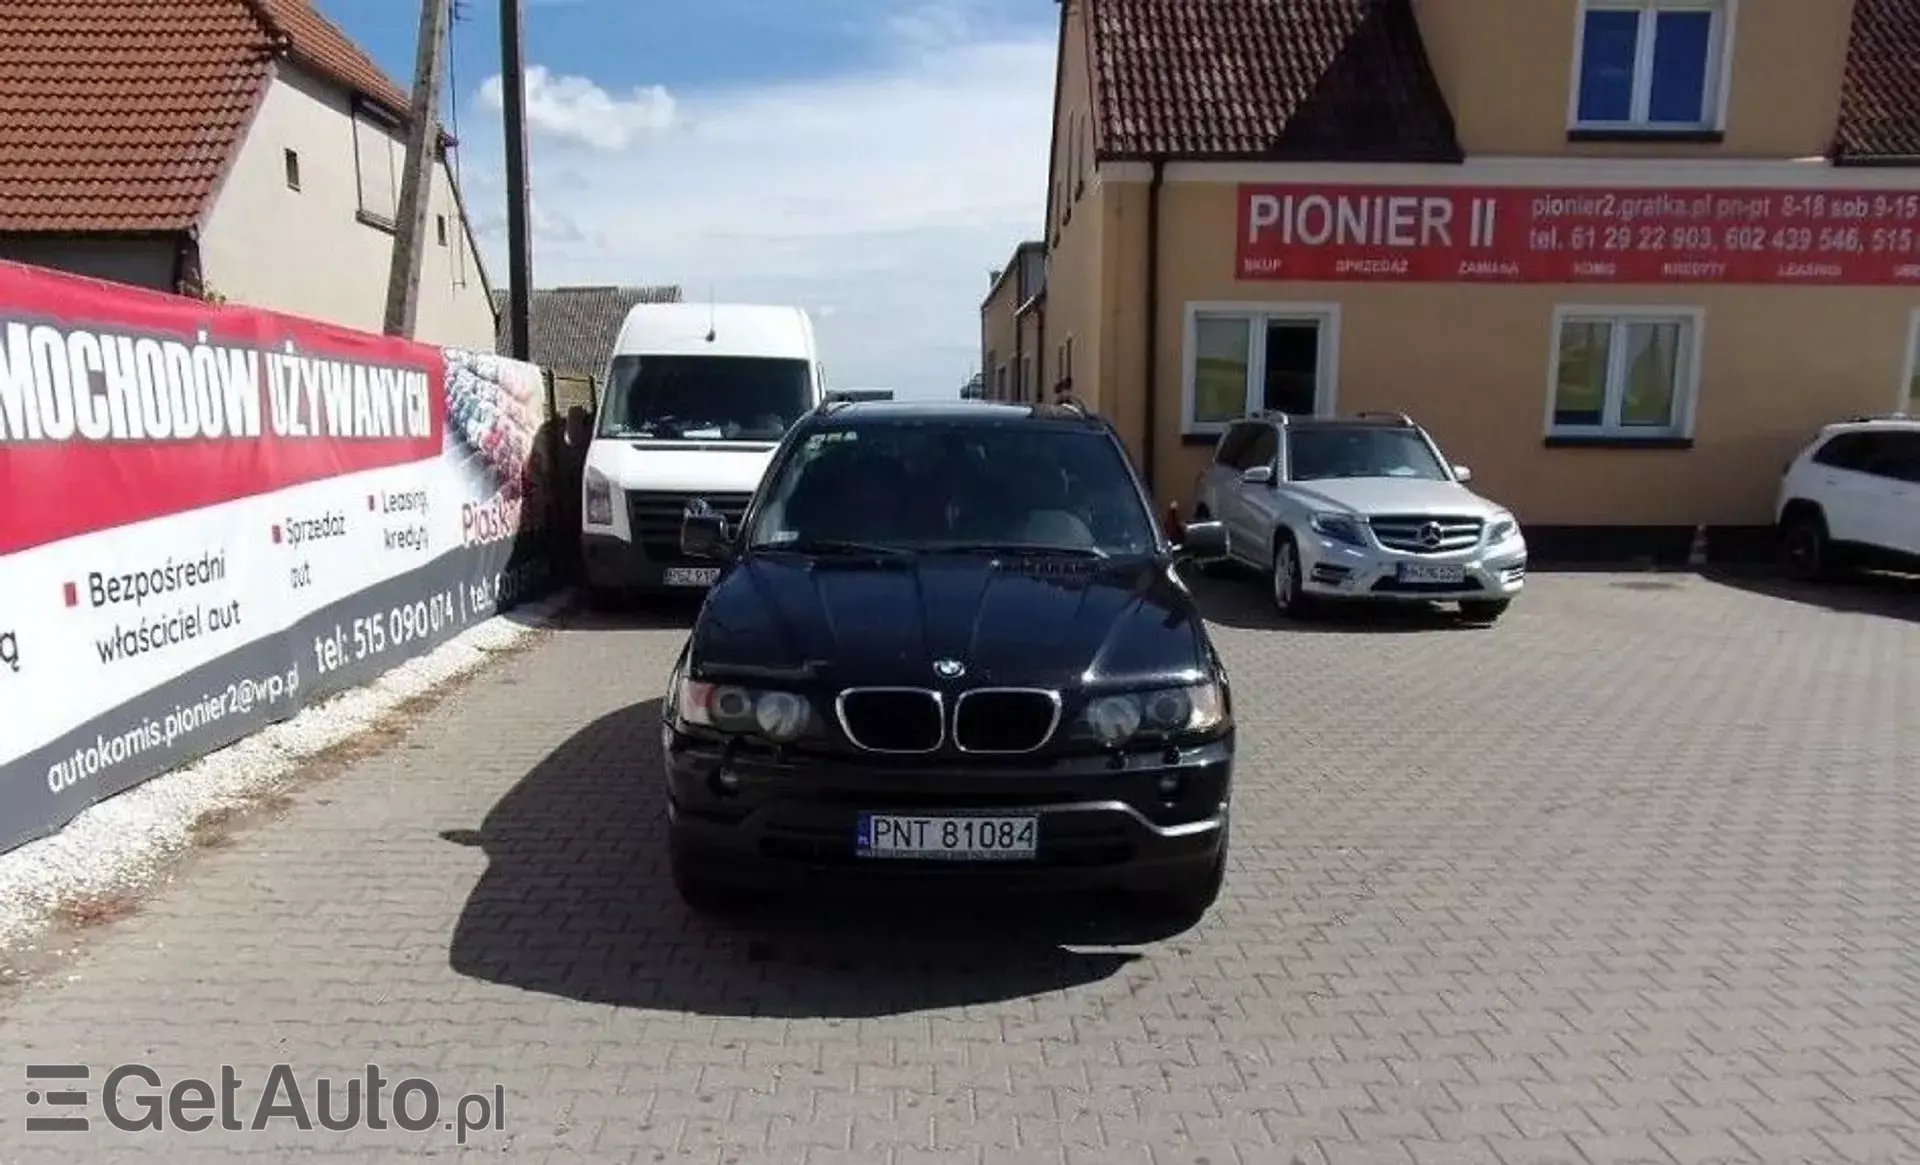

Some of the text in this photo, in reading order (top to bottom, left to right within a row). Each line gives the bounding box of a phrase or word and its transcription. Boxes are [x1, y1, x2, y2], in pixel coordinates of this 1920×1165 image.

[1249, 194, 1496, 247] PIONIER II
[1780, 195, 1825, 218] 8-18
[1831, 196, 1868, 218] sob
[1873, 195, 1918, 219] 9-15
[1529, 226, 1564, 250] tel.
[1571, 227, 1595, 250] 61
[1603, 227, 1631, 250] 29
[1637, 226, 1666, 250] 22
[1725, 227, 1766, 251] 602
[1772, 228, 1812, 251] 439
[1870, 228, 1912, 251] 515
[265, 340, 432, 439] UŻYWANYCH
[286, 510, 347, 549] Sprzedaż
[88, 549, 226, 607] Bezpośredni
[290, 561, 312, 590] aut
[95, 599, 241, 665] właściciel aut
[46, 662, 299, 793] autokomis.pionier2@wp.pl
[314, 623, 349, 674] tel:
[353, 612, 385, 660] 515
[389, 600, 428, 645] 090
[429, 588, 454, 632] 074
[873, 819, 1034, 849] PNT 81084
